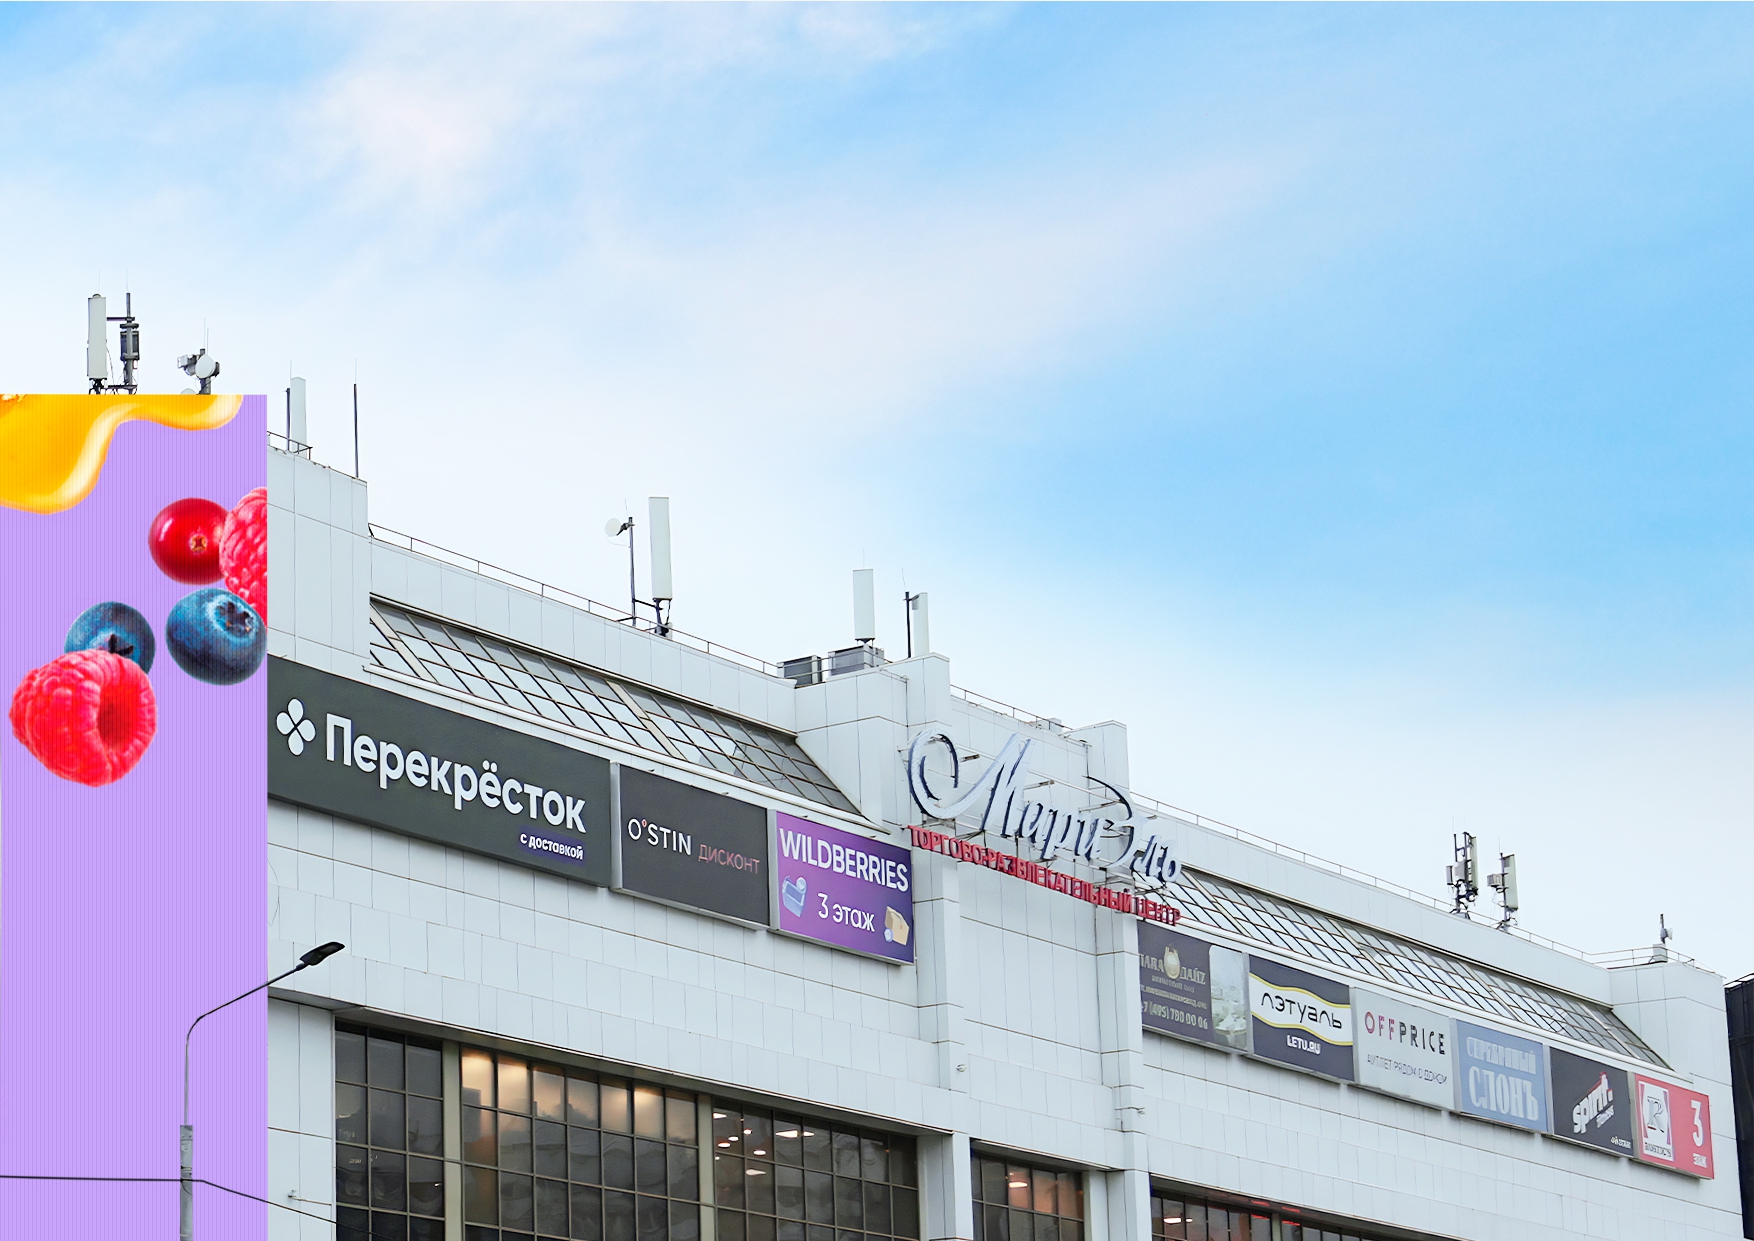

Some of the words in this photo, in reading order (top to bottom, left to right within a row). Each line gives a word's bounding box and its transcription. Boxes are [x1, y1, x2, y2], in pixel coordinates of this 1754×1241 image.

[325, 711, 588, 835] Перекрёсток
[528, 835, 584, 861] доставкой
[698, 844, 761, 875] ДИСКОНТ
[779, 827, 910, 893] WILDBERRIES
[817, 893, 830, 919] 3
[832, 903, 876, 933] этаж
[1468, 1065, 1539, 1121] СЛОНЪ
[1691, 1100, 1704, 1147] 3
